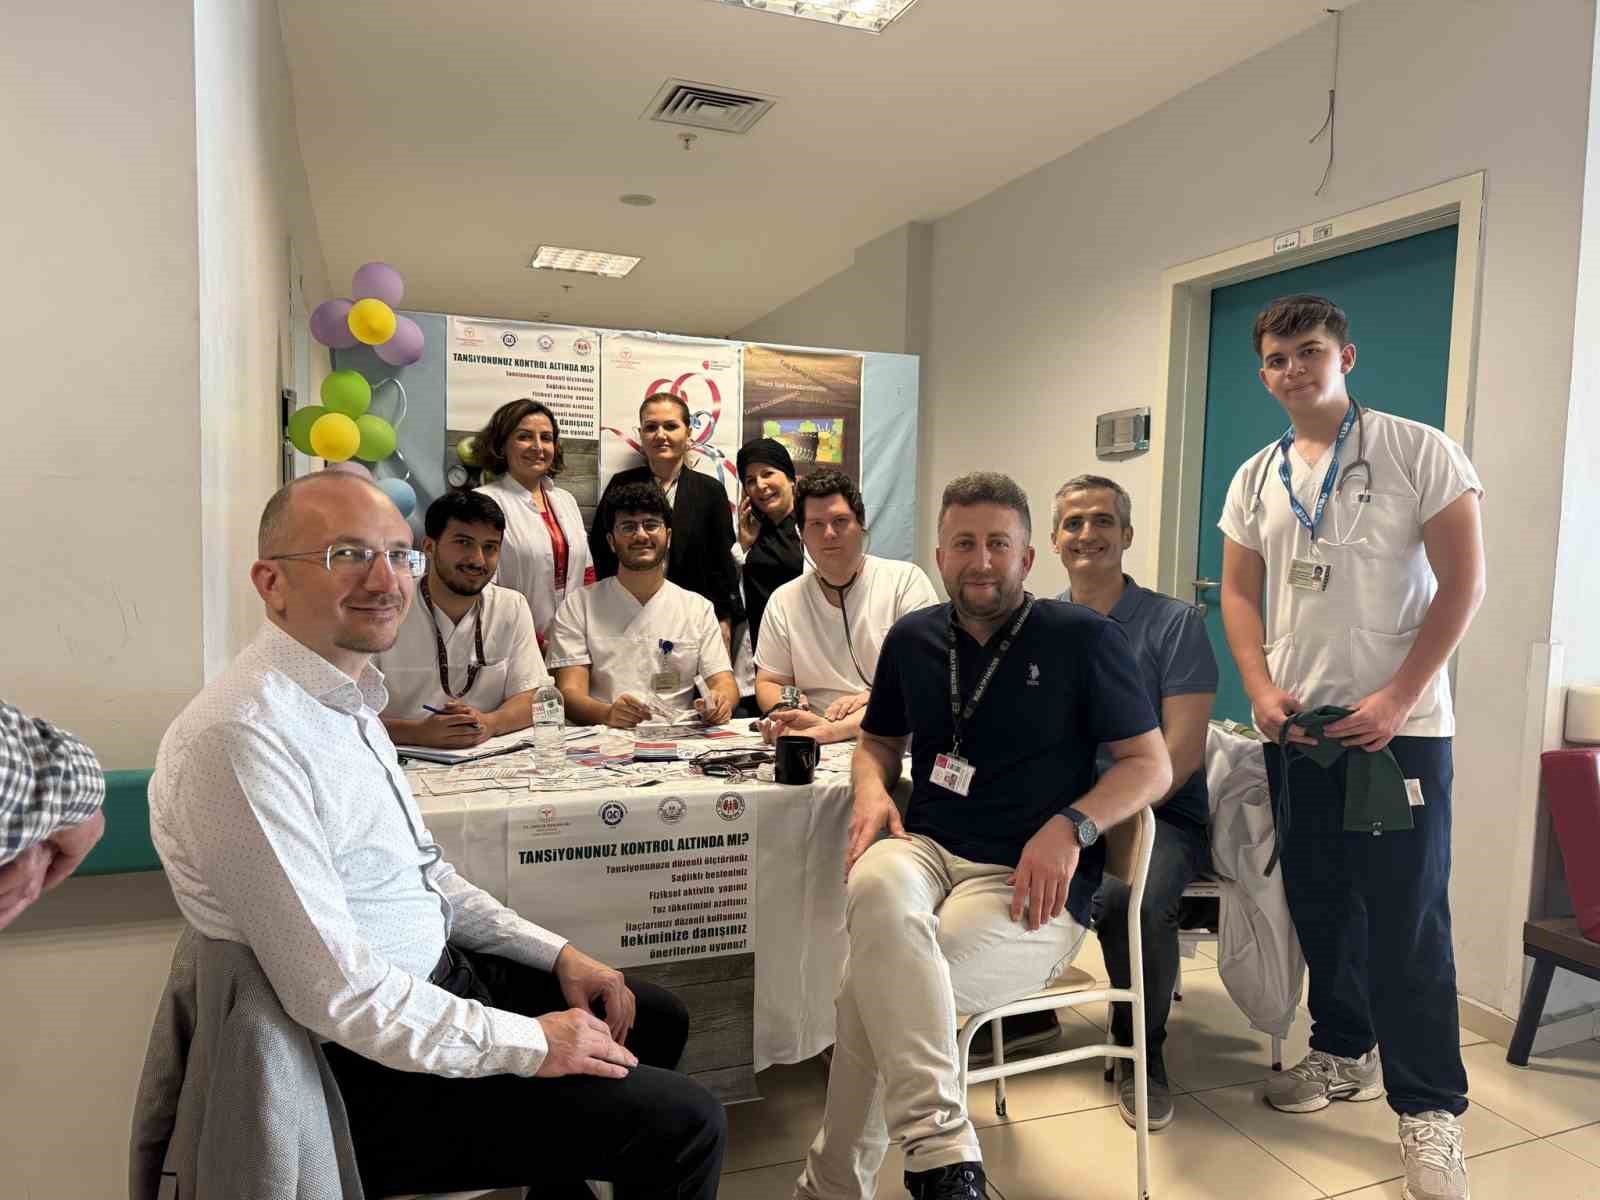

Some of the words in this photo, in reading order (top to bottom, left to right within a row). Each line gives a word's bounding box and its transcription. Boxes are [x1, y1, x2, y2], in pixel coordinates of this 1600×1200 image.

[621, 838, 675, 856] KONTROL
[677, 834, 724, 851] ALTINDA
[727, 832, 750, 847] MI?
[671, 872, 703, 883] Sağlıklı
[705, 867, 748, 880] besleniniz
[649, 889, 682, 900] Fiziksel
[683, 885, 715, 897] aktivite
[718, 882, 748, 894] yapınız
[653, 906, 666, 914] Tuz
[668, 901, 711, 912] tüketimini
[674, 915, 705, 927] düzenli
[707, 911, 748, 923] kullanınız
[621, 931, 688, 947] Hekiminize
[692, 923, 747, 939] danışınız
[650, 944, 706, 958] önerilerine
[709, 938, 747, 953] uyunuz!
